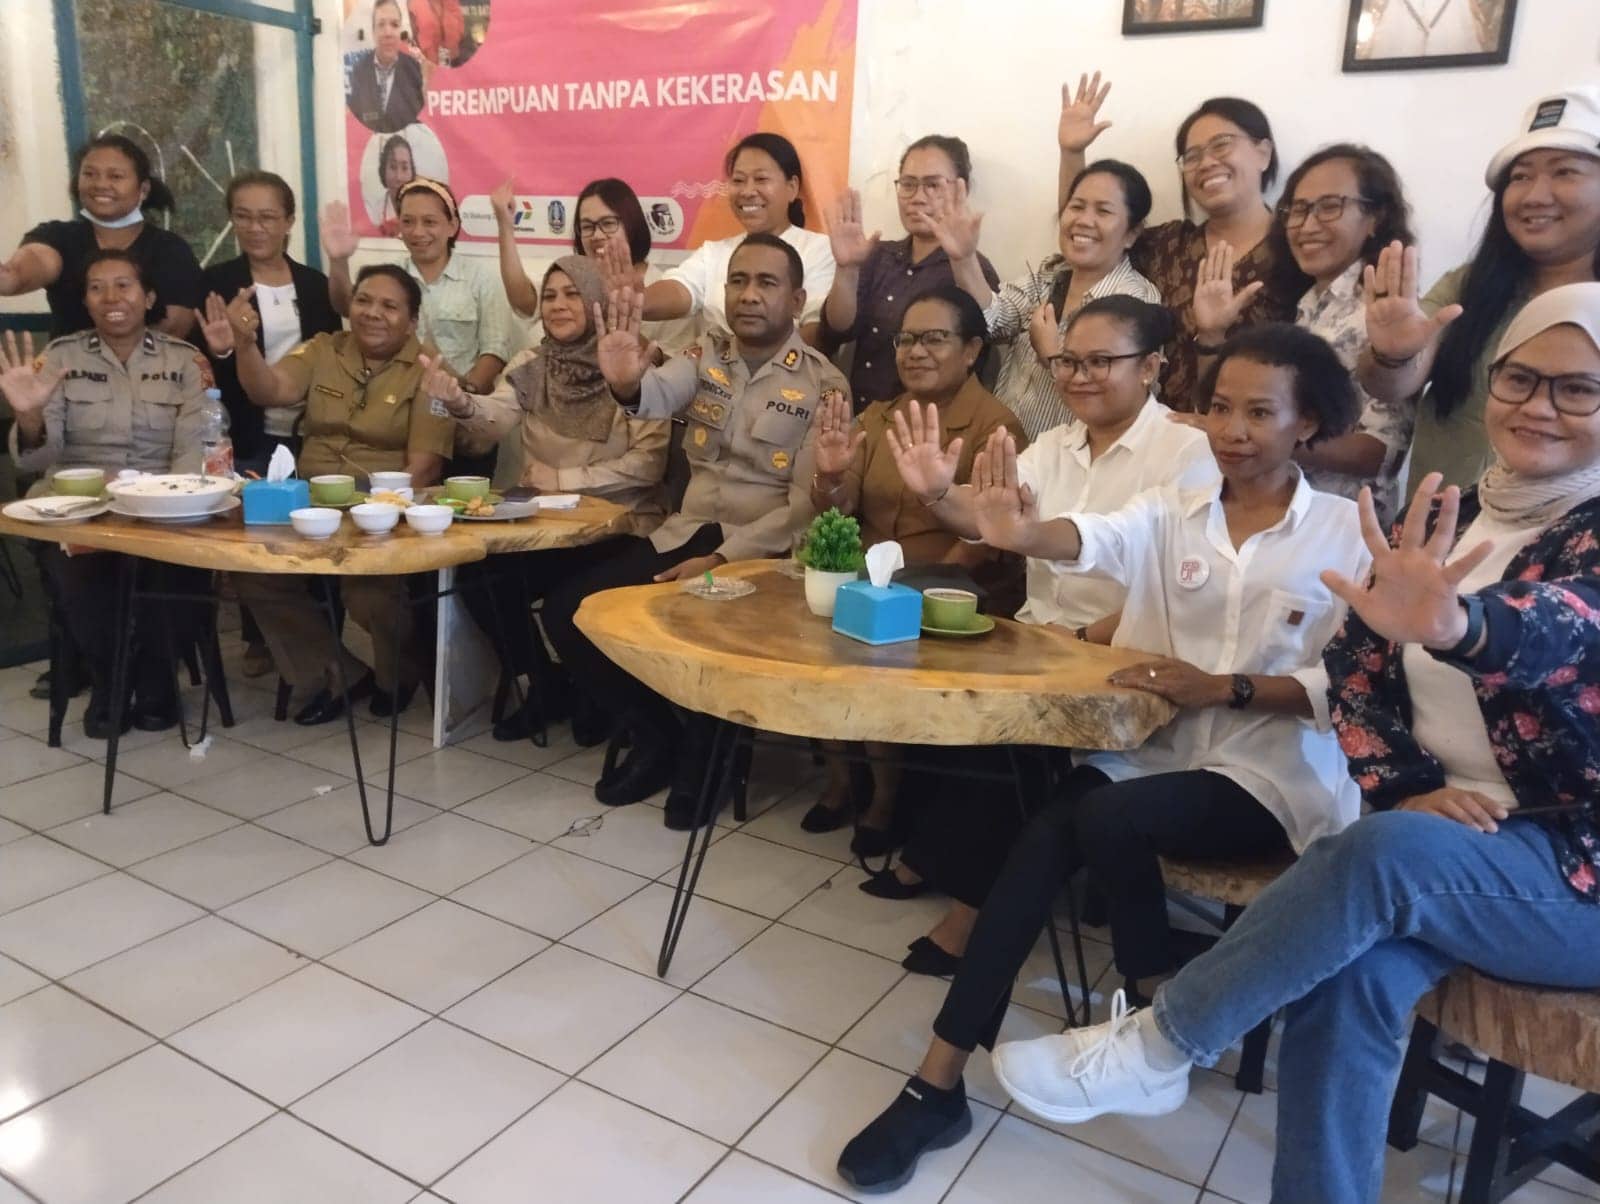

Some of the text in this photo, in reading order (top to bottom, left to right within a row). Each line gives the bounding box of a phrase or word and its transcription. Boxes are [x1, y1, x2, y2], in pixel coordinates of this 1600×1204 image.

[427, 70, 838, 116] PEREMPUAN TANPA KEKERASAN
[141, 371, 184, 384] POLRI
[766, 401, 810, 420] POLRI
